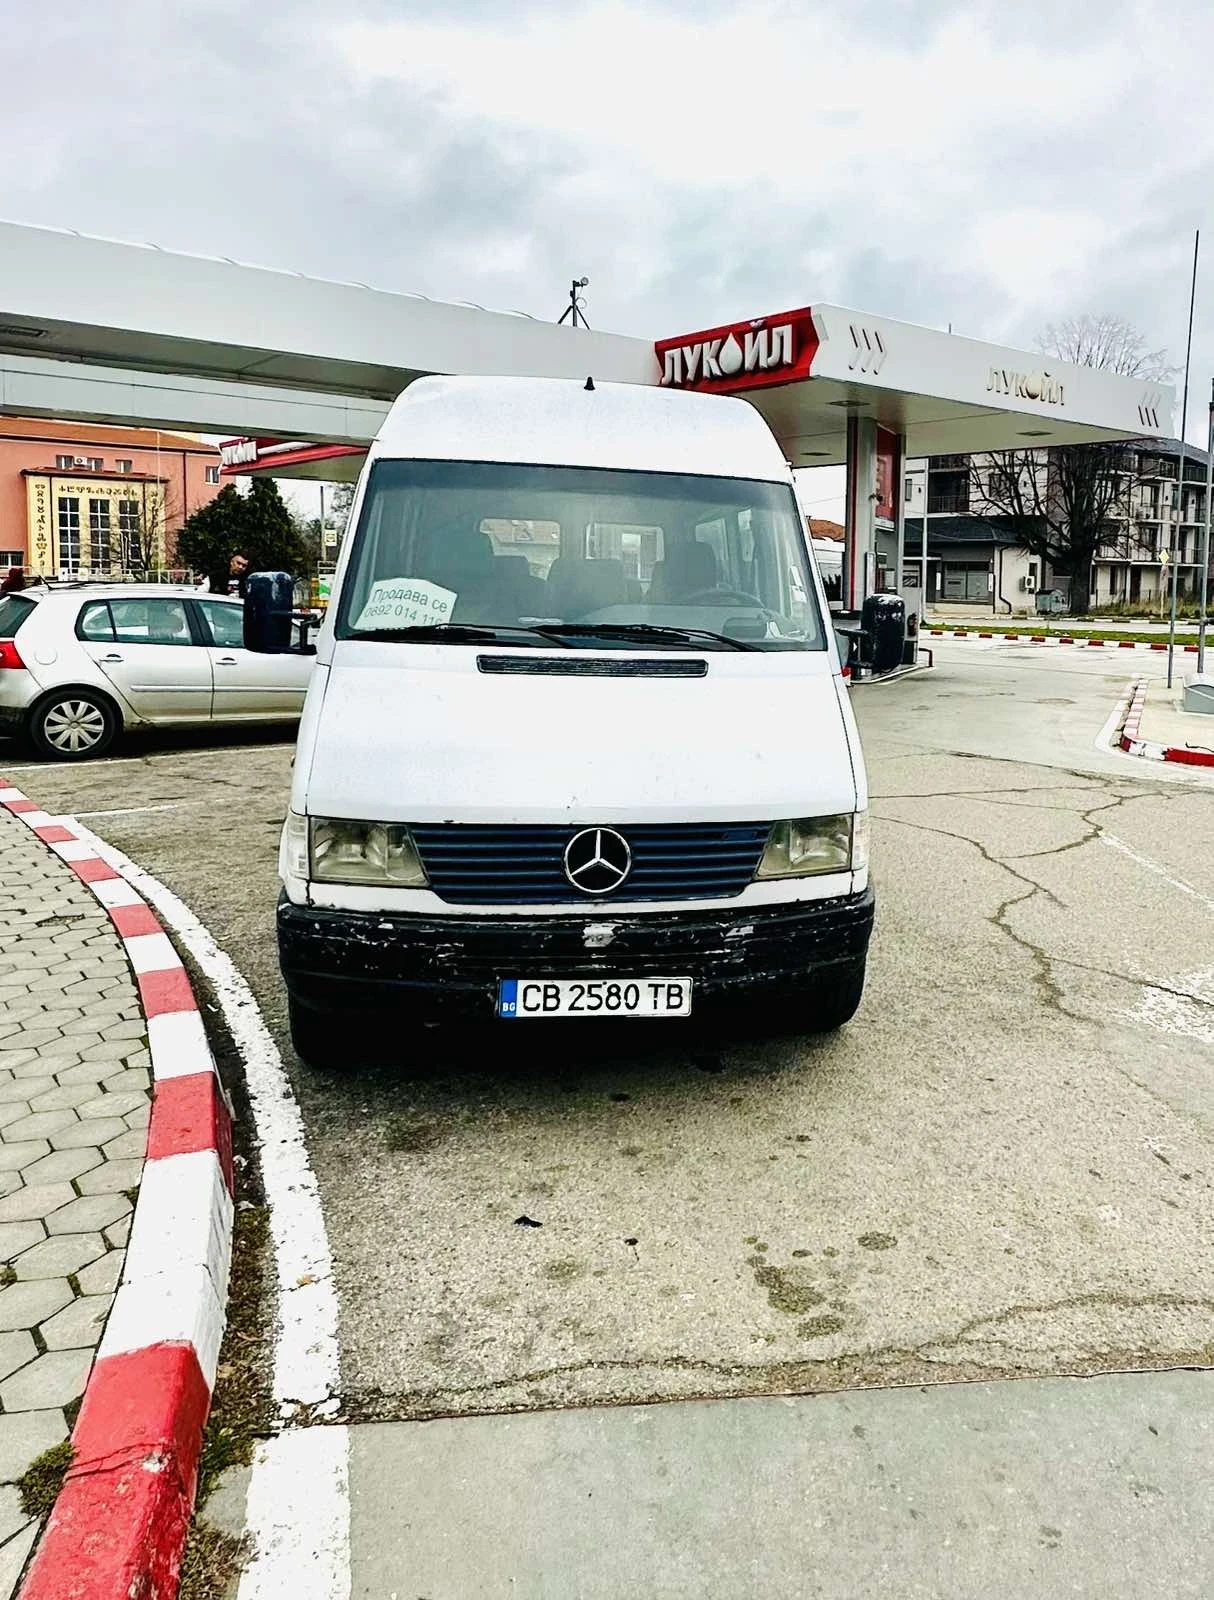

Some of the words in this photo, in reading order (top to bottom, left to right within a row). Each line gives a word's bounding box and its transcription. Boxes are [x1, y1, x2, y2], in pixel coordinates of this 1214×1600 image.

[661, 319, 793, 385] ЛУКОЙЛ
[373, 588, 428, 606] Продава
[432, 599, 447, 613] се
[395, 605, 417, 620] 014
[502, 1002, 516, 1012] BG
[522, 984, 561, 1011] CB
[568, 983, 640, 1011] 2580
[648, 983, 683, 1010] TB
